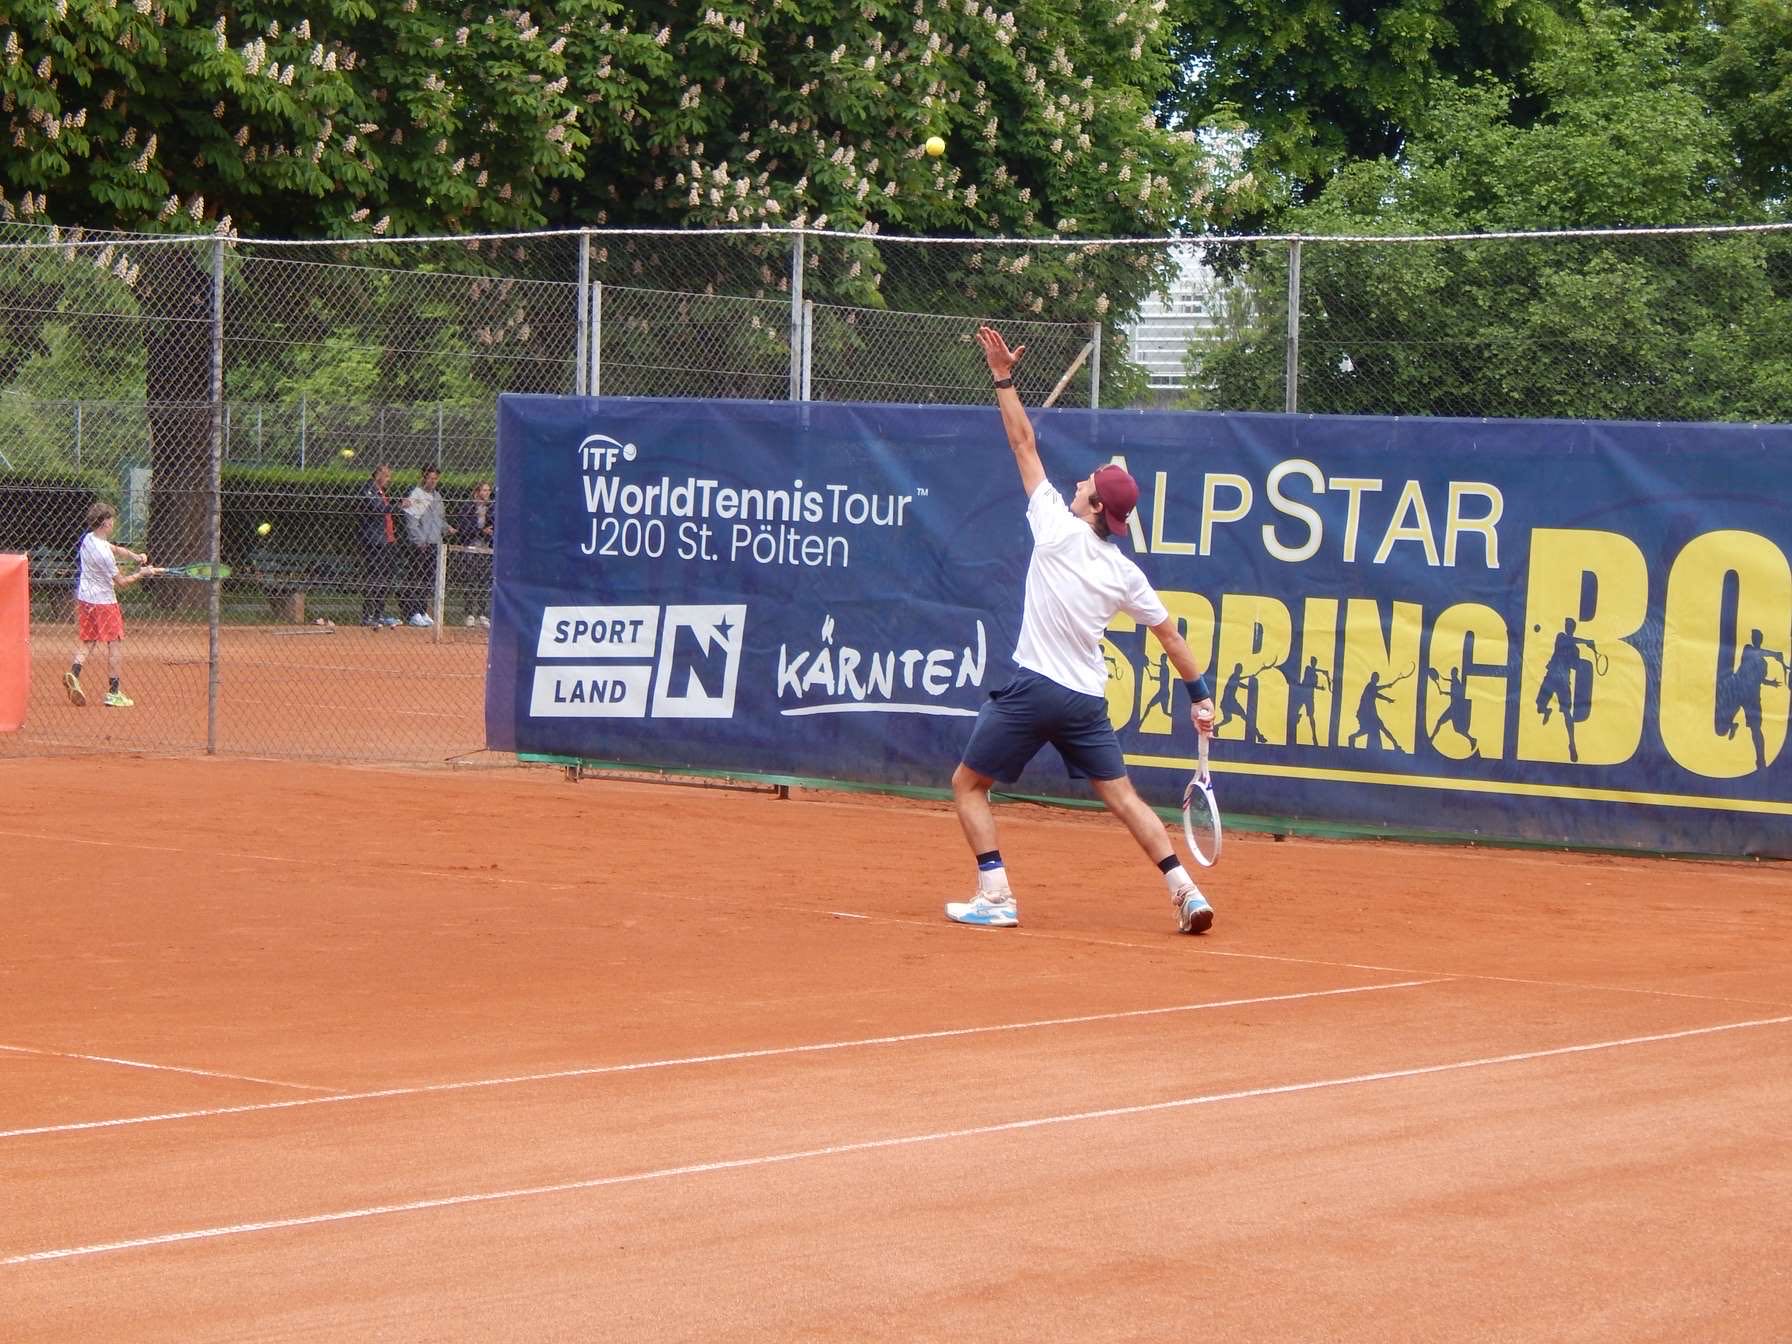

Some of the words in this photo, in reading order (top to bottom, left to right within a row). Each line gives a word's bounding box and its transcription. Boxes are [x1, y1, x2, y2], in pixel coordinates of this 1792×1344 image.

[582, 447, 619, 471] ITF
[582, 475, 912, 526] WorldTennisTour
[581, 517, 665, 558] J200
[677, 522, 718, 561] St.
[731, 524, 849, 567] Pölten
[553, 620, 644, 643] SPORT
[777, 614, 987, 700] KÄRNTEN
[553, 680, 627, 703] LAND
